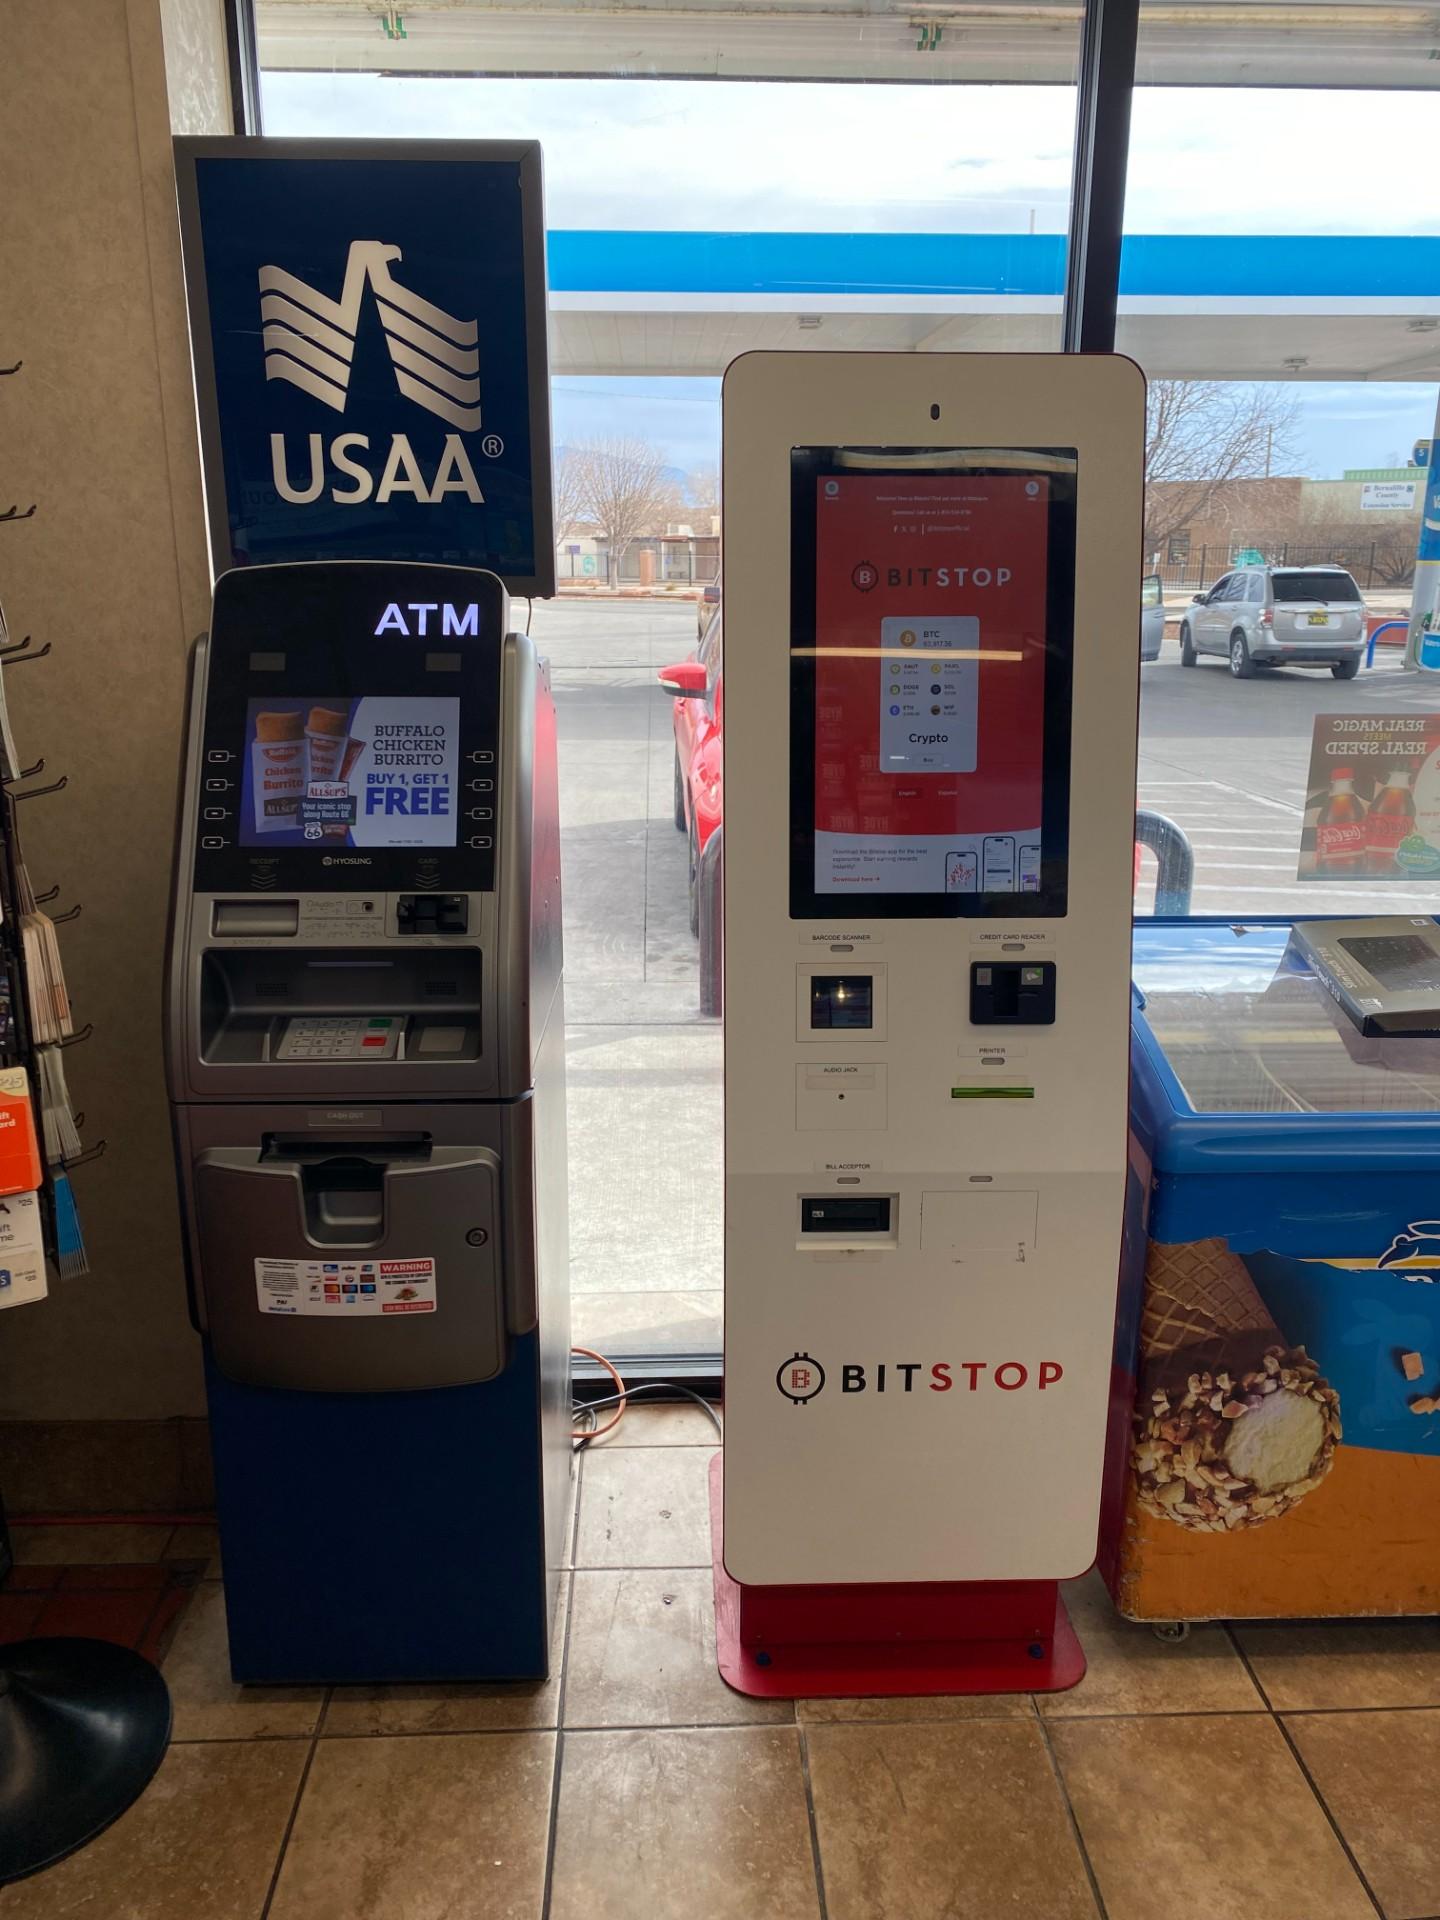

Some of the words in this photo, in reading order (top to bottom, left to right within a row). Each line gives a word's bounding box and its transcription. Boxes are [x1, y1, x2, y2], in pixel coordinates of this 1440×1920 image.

[271, 433, 485, 505] USAA
[887, 568, 1011, 586] BITSTOP
[374, 603, 478, 636] ATM
[374, 725, 445, 737] BUFFALO
[909, 733, 949, 745] Crypto
[372, 739, 446, 751] CHICKEN
[374, 754, 444, 765] BURRITO
[265, 767, 302, 777] Chicken
[263, 779, 304, 790] Burrito
[367, 773, 395, 785] BUY
[398, 773, 409, 786] 1,
[412, 773, 439, 785] GET
[442, 773, 449, 785] 1
[310, 786, 347, 797] ALLSUP'S
[317, 802, 336, 810] iconic
[337, 802, 352, 812] stop
[365, 787, 450, 816] FREE
[322, 810, 340, 818] Route
[306, 828, 321, 838] 66
[333, 857, 373, 865] HYOSUNG
[382, 1262, 431, 1272] WARNING
[842, 1361, 1064, 1393] BITSTOP
